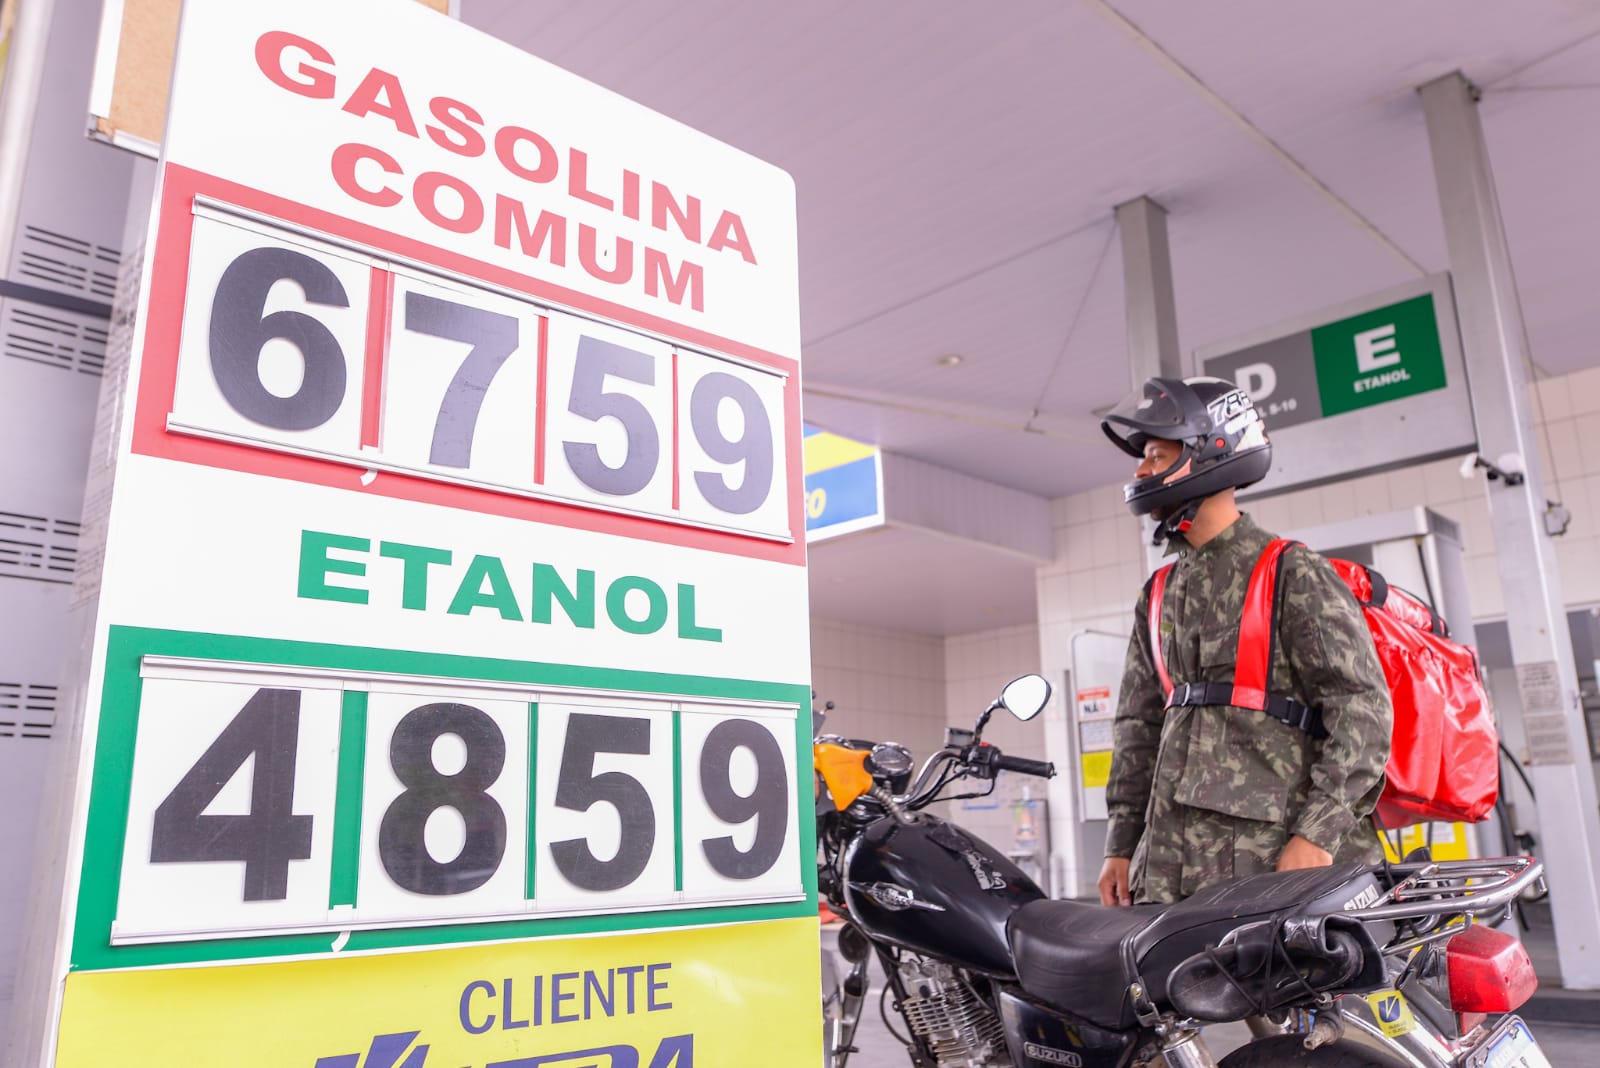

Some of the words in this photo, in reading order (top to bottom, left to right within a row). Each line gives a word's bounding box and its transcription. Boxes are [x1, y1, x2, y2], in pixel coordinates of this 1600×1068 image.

[254, 29, 758, 267] GASOLINA
[331, 141, 706, 314] COMUM
[1353, 323, 1401, 374] E
[1235, 362, 1277, 402] D
[1353, 368, 1411, 393] ETANOL
[297, 529, 723, 643] ETANOL
[458, 962, 673, 1035] CLIENTE
[1027, 1045, 1078, 1066] SUZUKI
